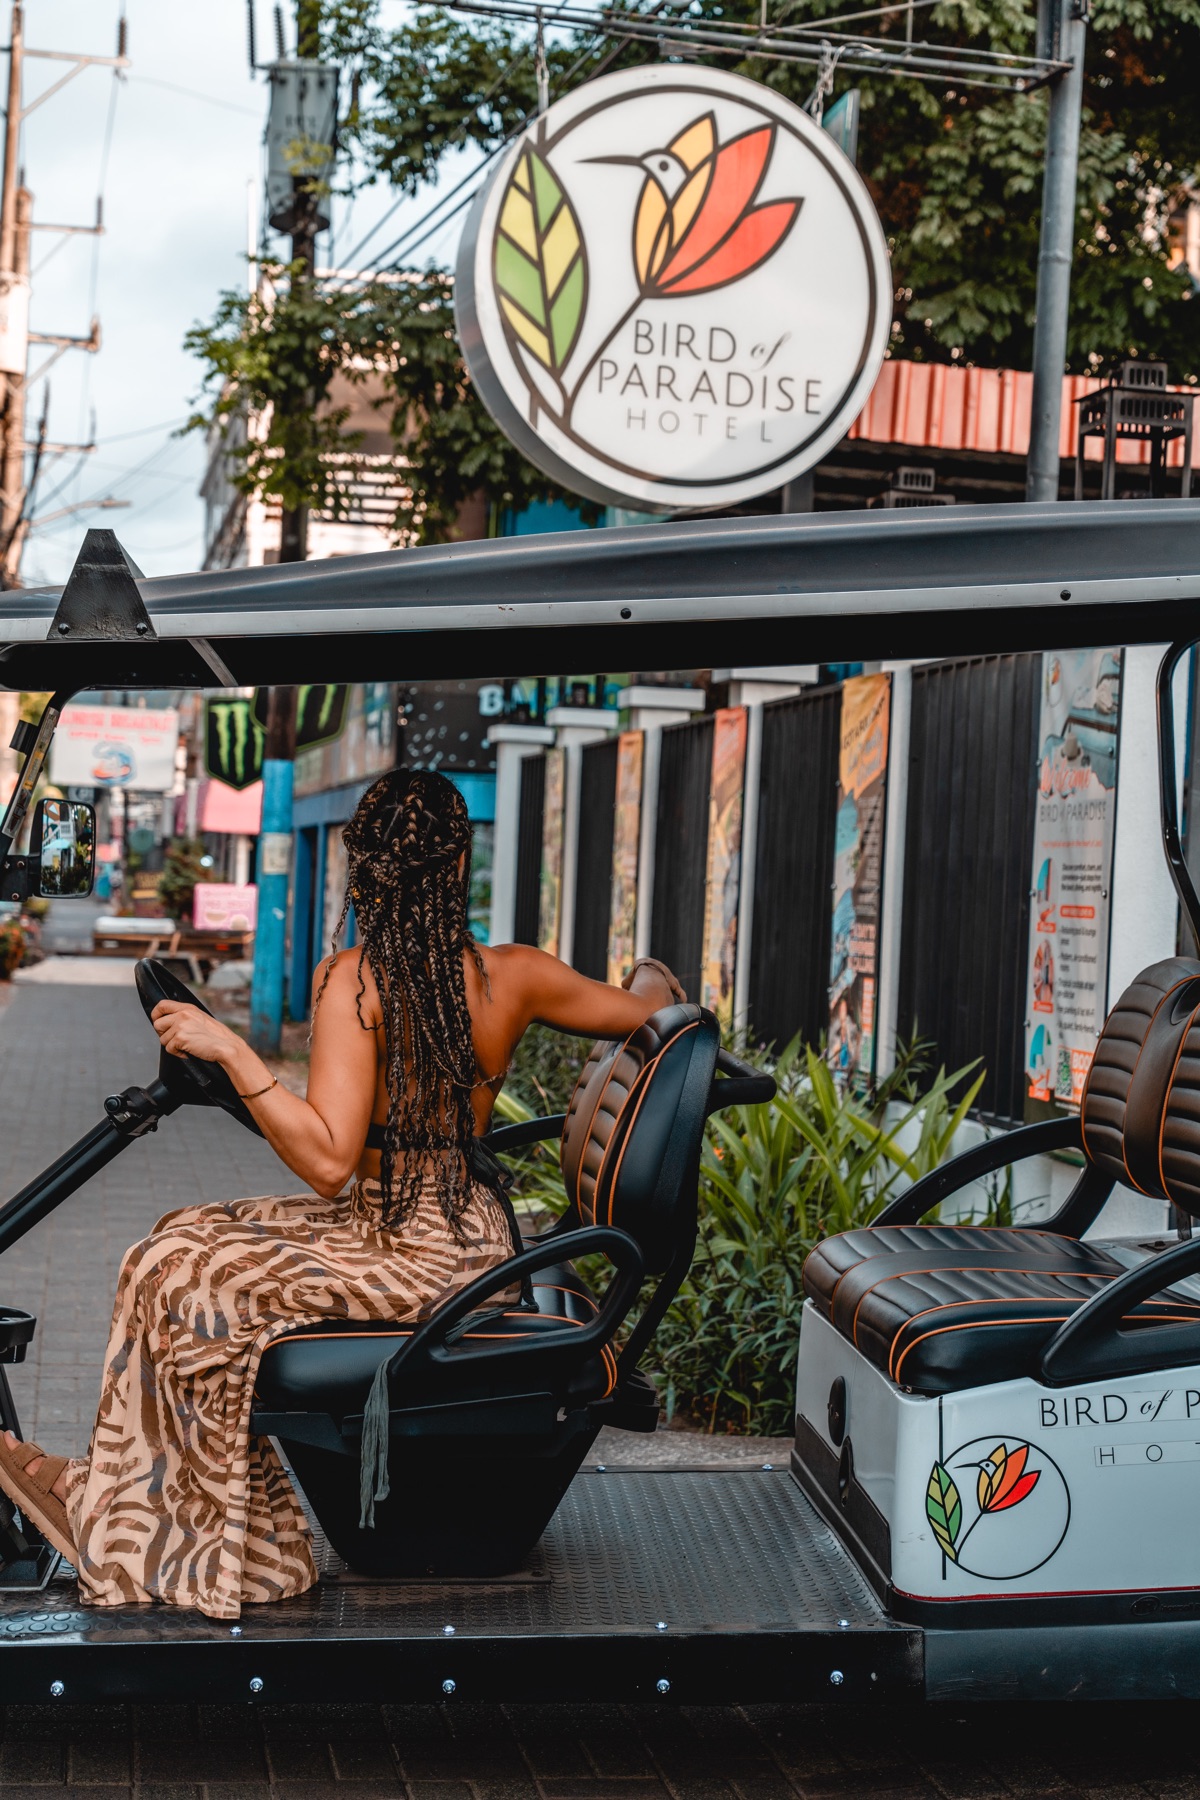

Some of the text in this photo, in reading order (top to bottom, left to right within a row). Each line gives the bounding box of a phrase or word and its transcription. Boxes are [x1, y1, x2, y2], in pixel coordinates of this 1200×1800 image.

[634, 319, 792, 372] BIRD of
[598, 358, 822, 415] PARADISE
[626, 407, 773, 443] HOTEL
[1040, 1394, 1128, 1427] BIRD
[1140, 1389, 1174, 1422] of
